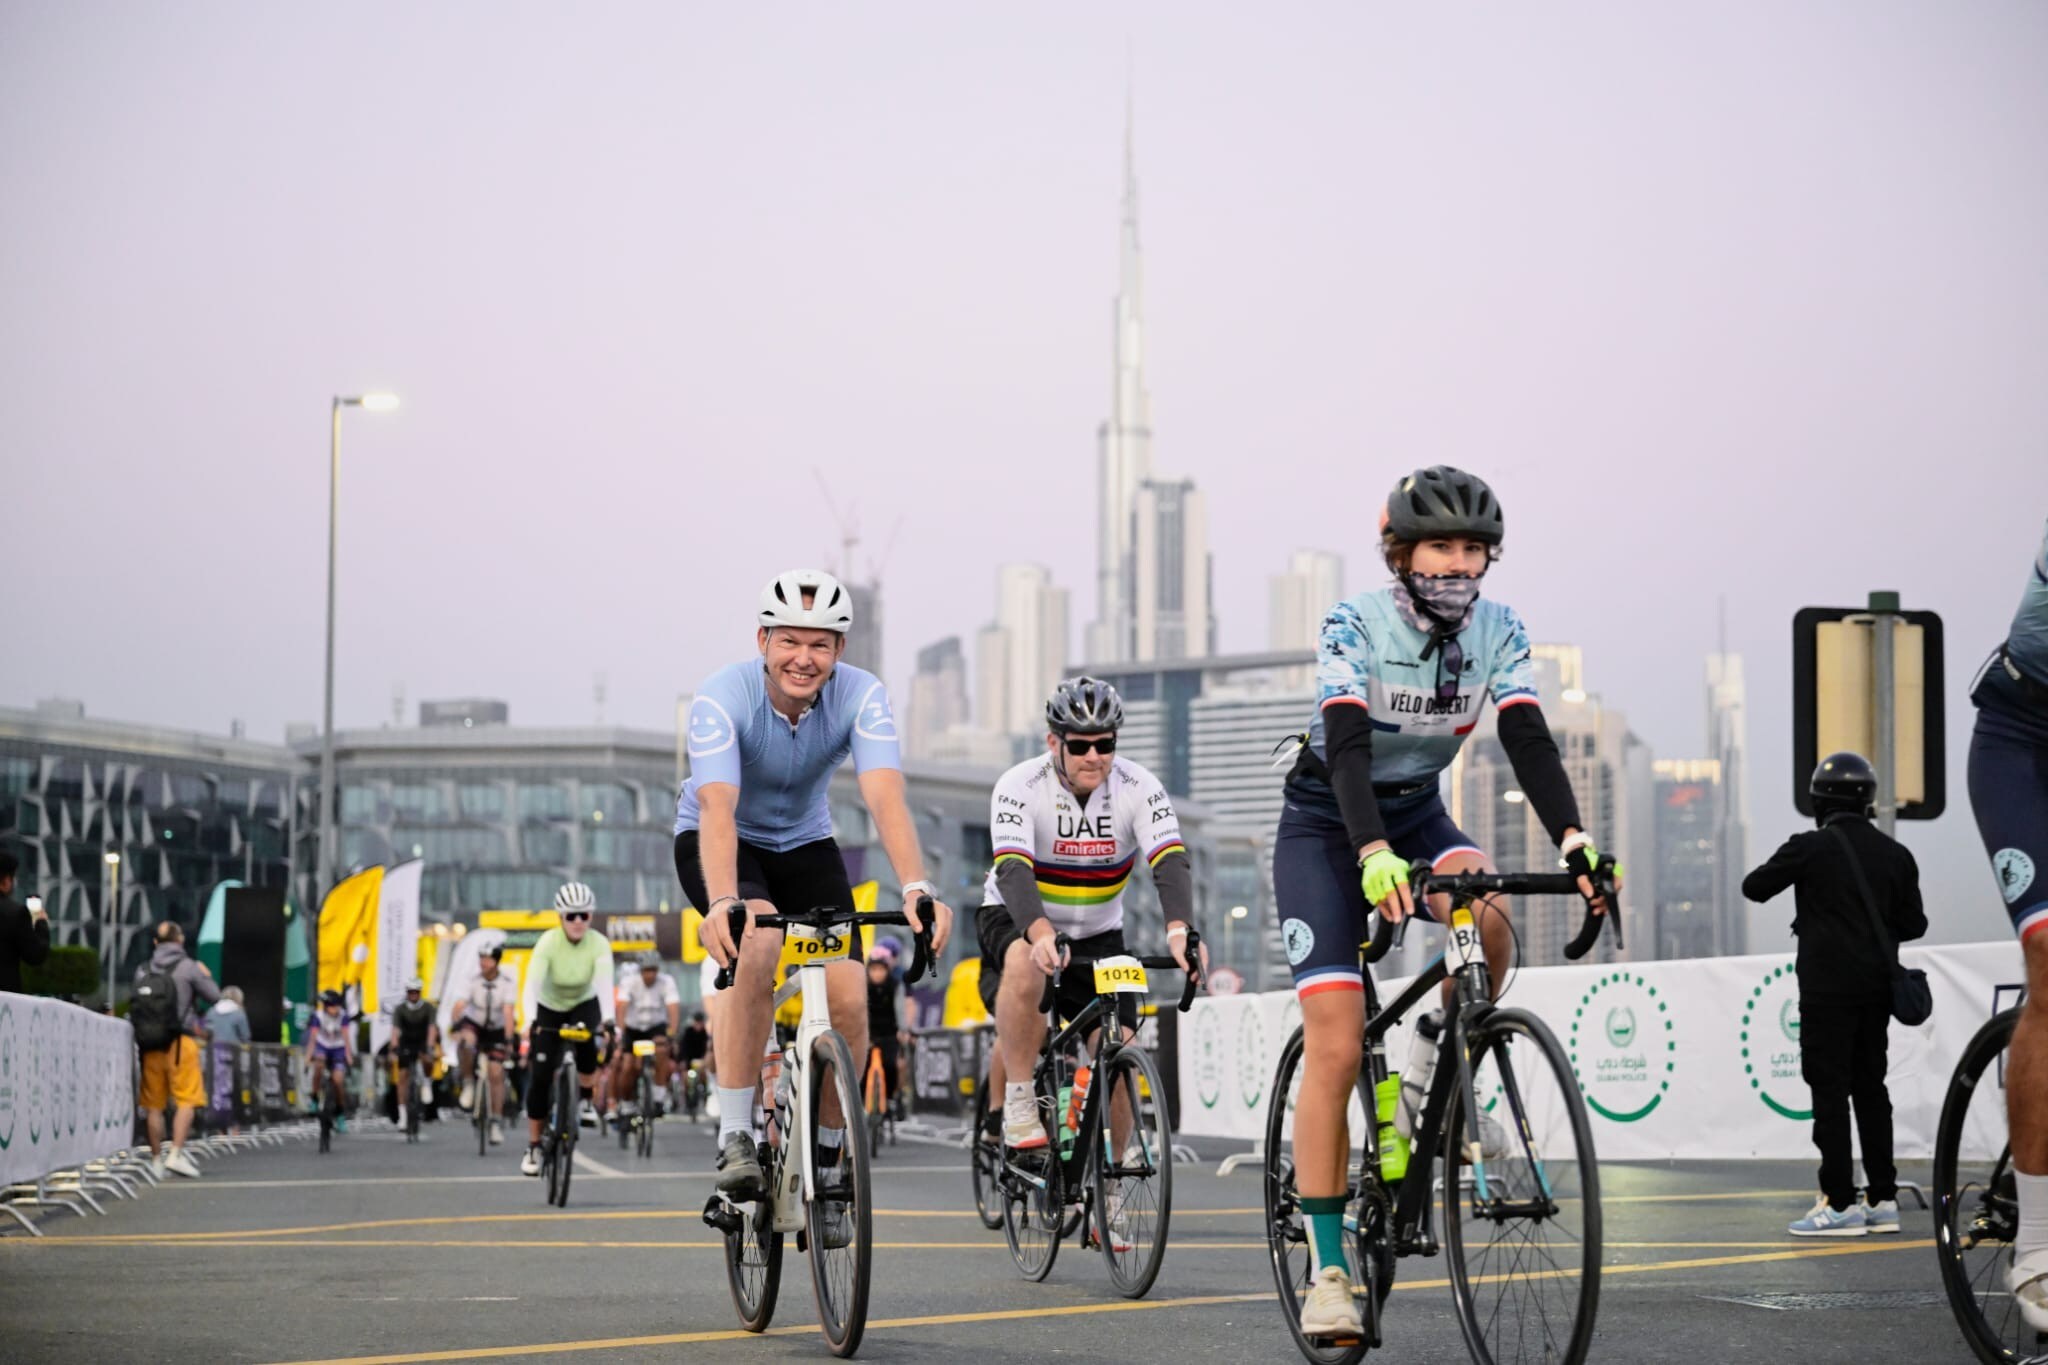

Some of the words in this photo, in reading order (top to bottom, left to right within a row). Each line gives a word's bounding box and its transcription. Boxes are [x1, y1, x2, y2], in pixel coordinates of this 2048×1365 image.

[1390, 690, 1422, 714] VÉLO
[1057, 814, 1113, 838] UAE
[1055, 841, 1114, 855] Emirates
[1102, 969, 1141, 981] 1012
